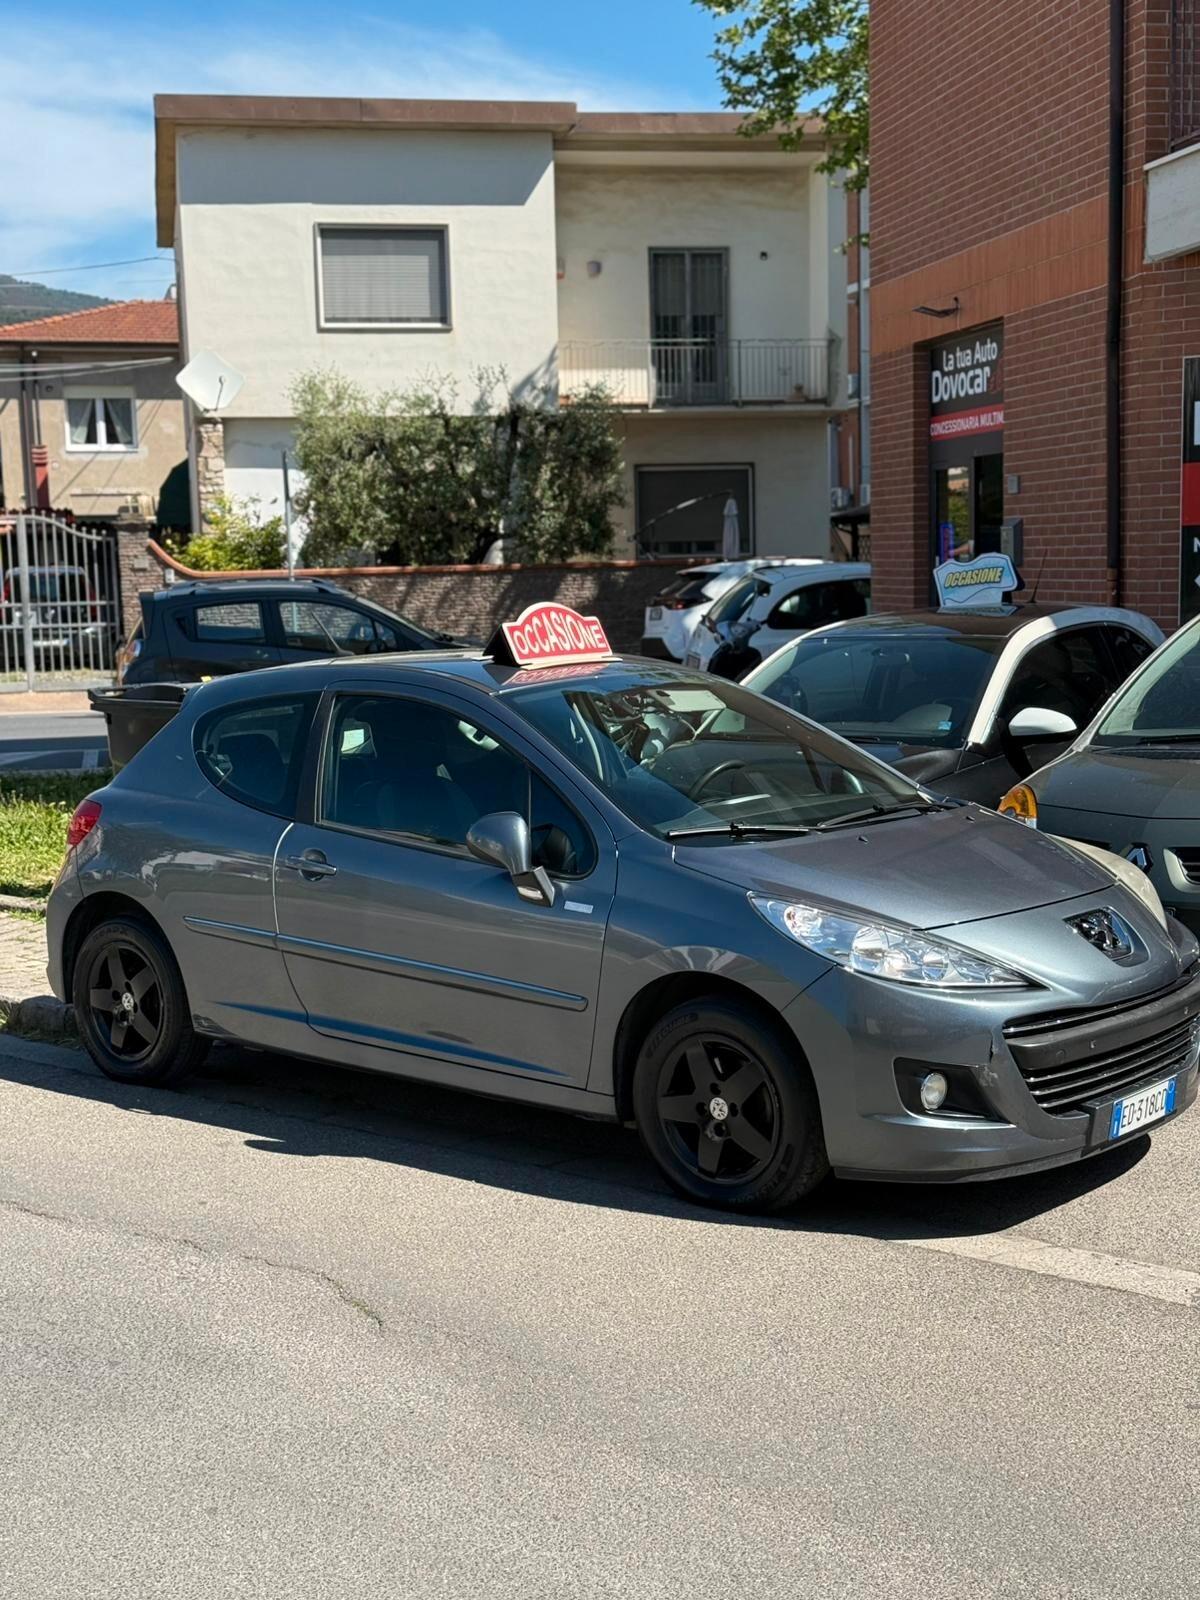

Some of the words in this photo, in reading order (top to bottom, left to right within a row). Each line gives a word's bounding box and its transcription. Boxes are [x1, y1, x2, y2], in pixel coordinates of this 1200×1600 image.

[942, 350, 954, 371] La
[956, 346, 971, 368] tua
[974, 338, 998, 365] Auto
[932, 366, 990, 403] Dovocar
[930, 415, 979, 436] CONCESSIONARIA
[944, 566, 1003, 589] OCCASIONE
[513, 610, 607, 655] OCCASIONE
